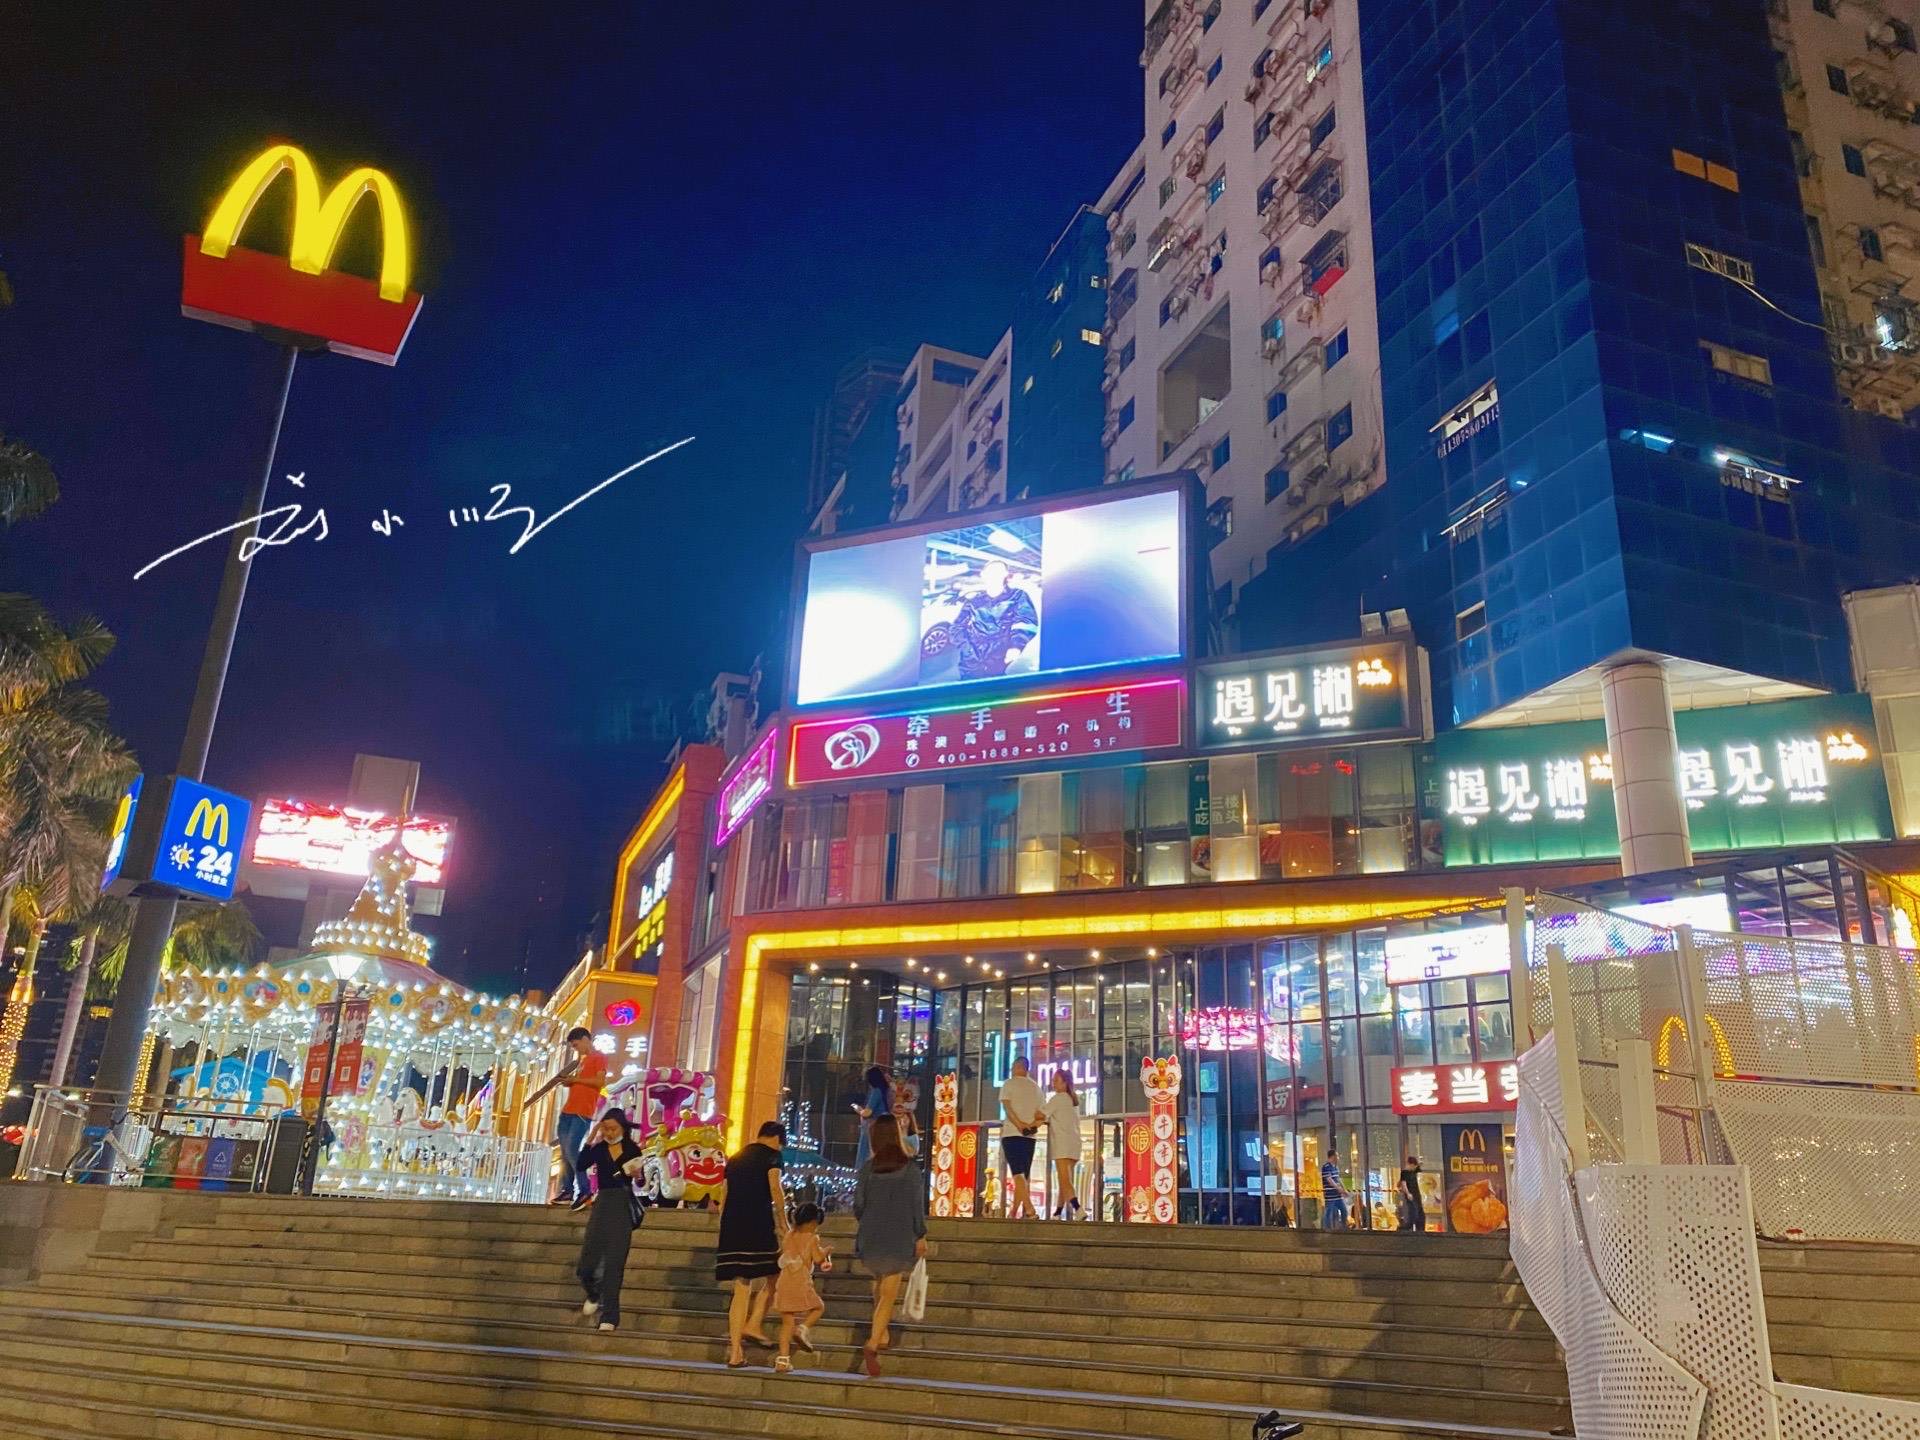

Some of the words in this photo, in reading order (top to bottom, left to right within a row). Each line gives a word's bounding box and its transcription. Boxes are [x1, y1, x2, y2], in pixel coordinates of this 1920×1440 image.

[1212, 666, 1353, 725] 遇见湘
[906, 692, 1131, 737] 牵手一生
[938, 741, 1068, 764] 400-1888-520
[1679, 739, 1828, 797] 遇见湘
[1447, 758, 1588, 815] 遇见湘
[1195, 794, 1240, 812] 上三楼
[1195, 810, 1240, 826] 吃鱼头
[196, 845, 233, 877] 24
[960, 1133, 976, 1158] 福
[1130, 1126, 1150, 1153] 福
[1154, 1115, 1172, 1220] 牛年大吉
